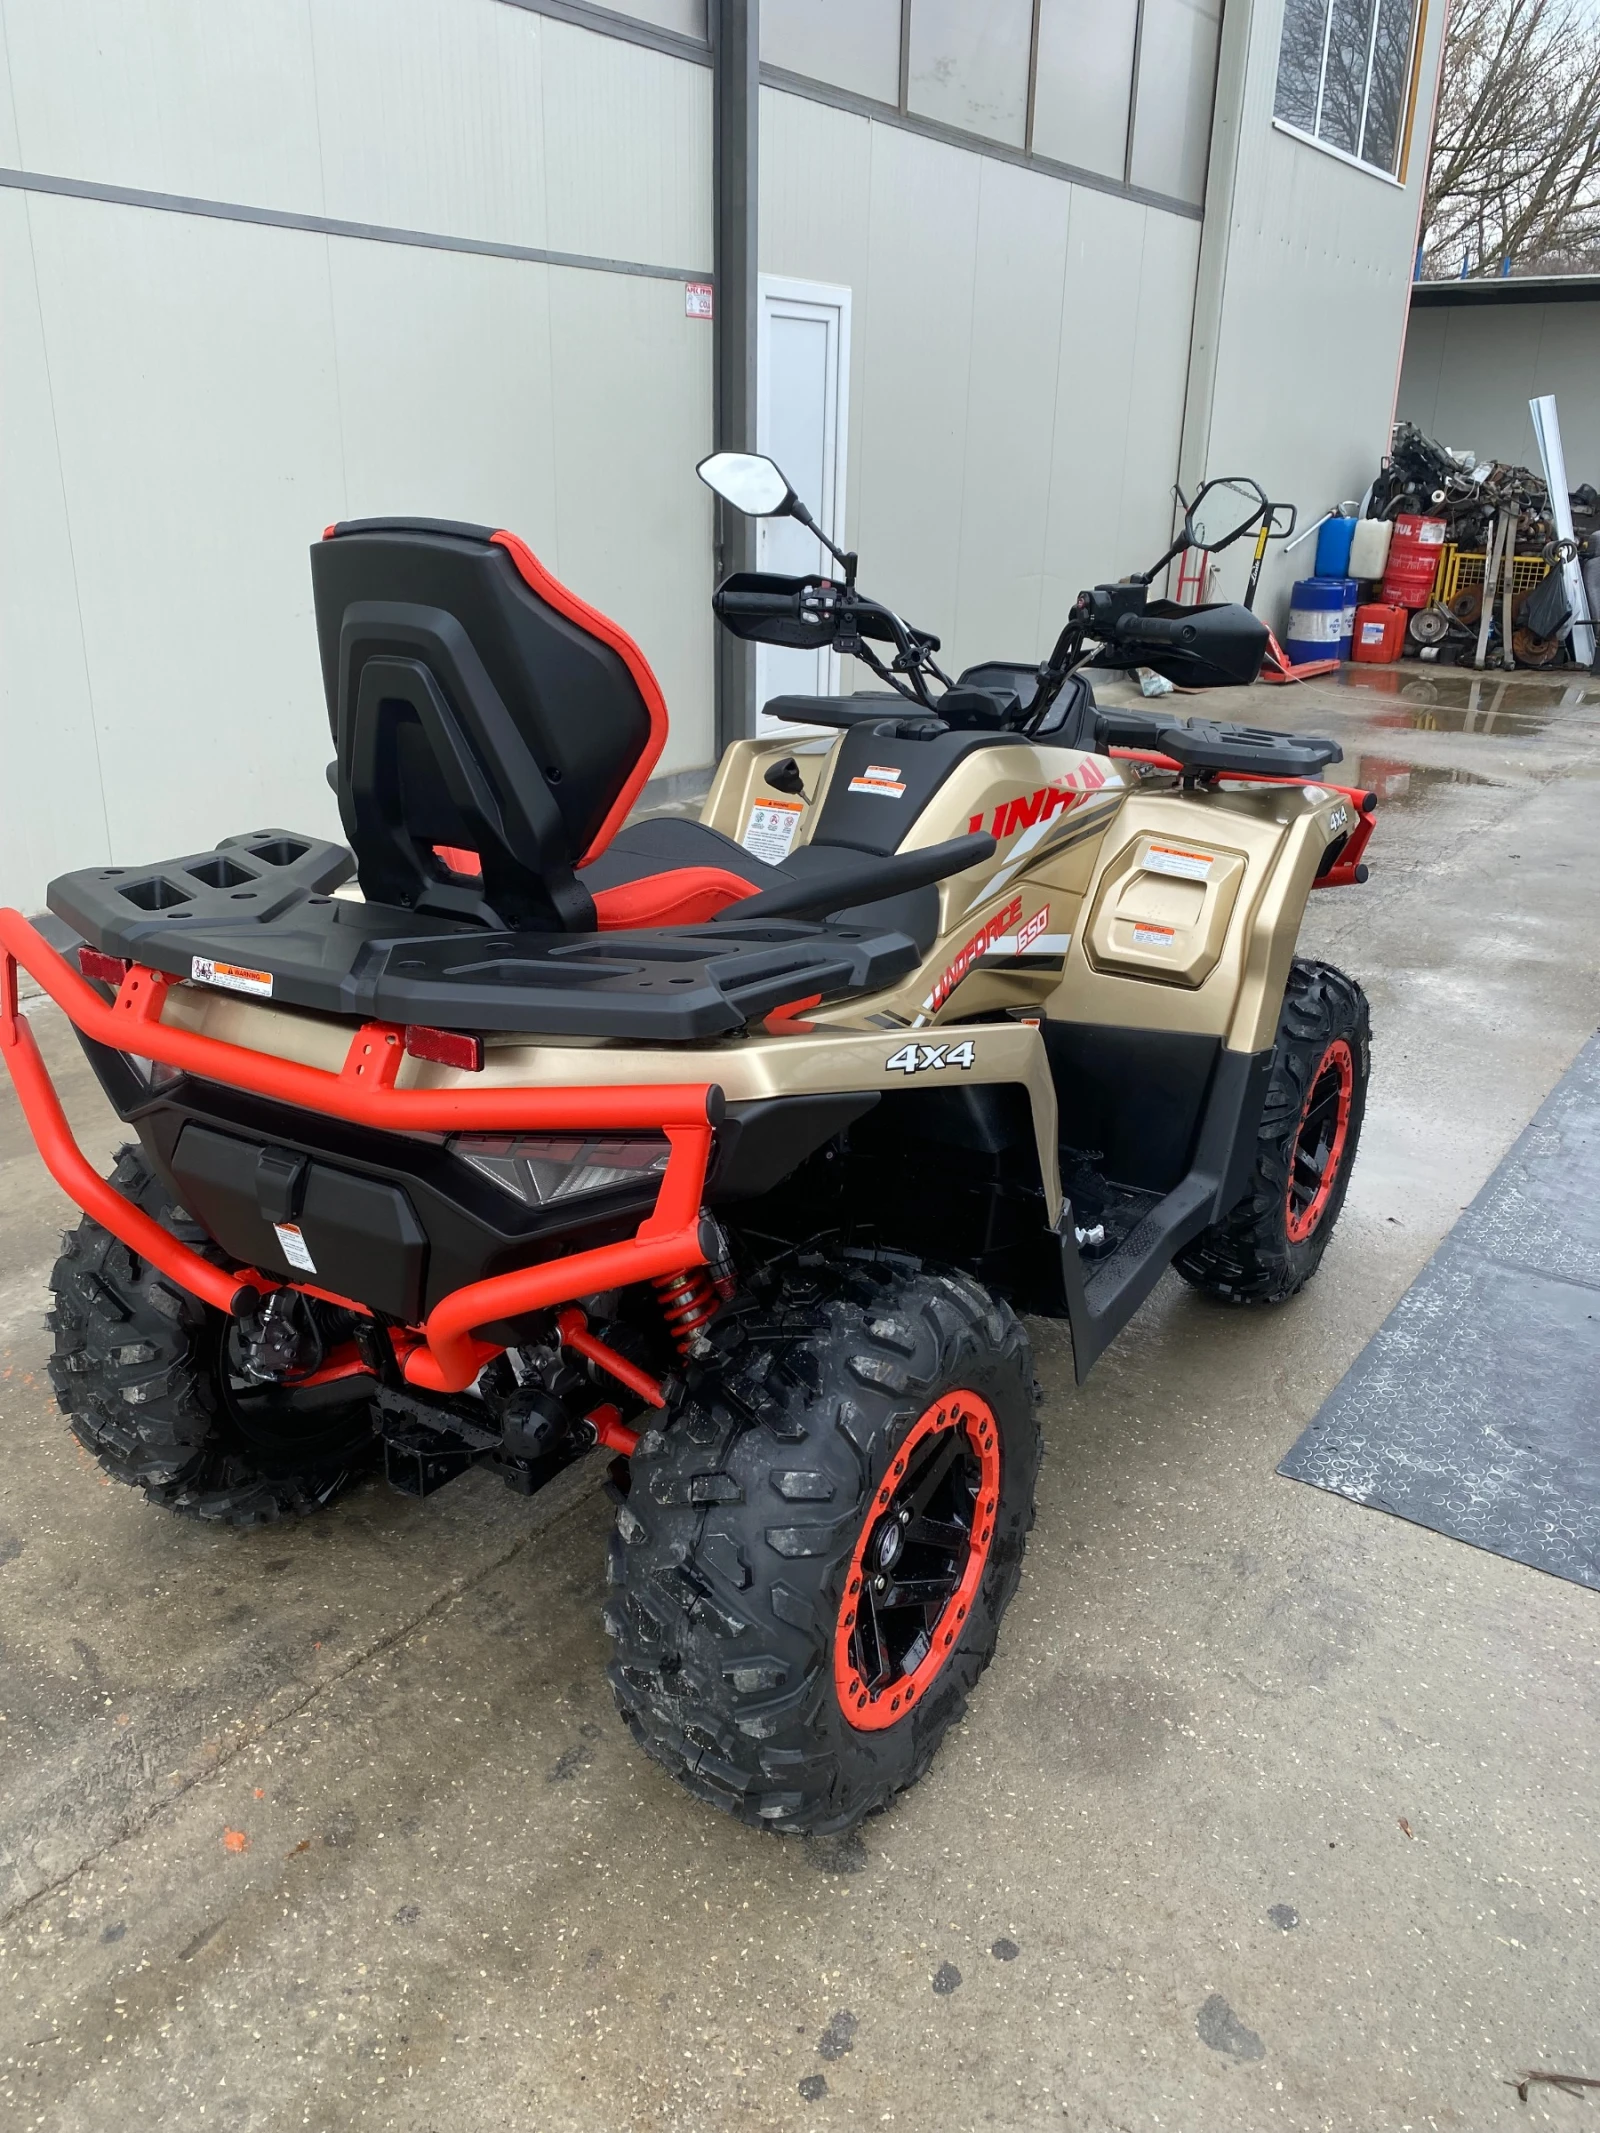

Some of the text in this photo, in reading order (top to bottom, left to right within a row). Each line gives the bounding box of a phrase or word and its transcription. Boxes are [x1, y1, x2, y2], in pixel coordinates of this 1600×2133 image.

[931, 895, 1023, 1013] LANDFORCE
[1016, 904, 1050, 955] 650
[234, 968, 261, 980] WARNING
